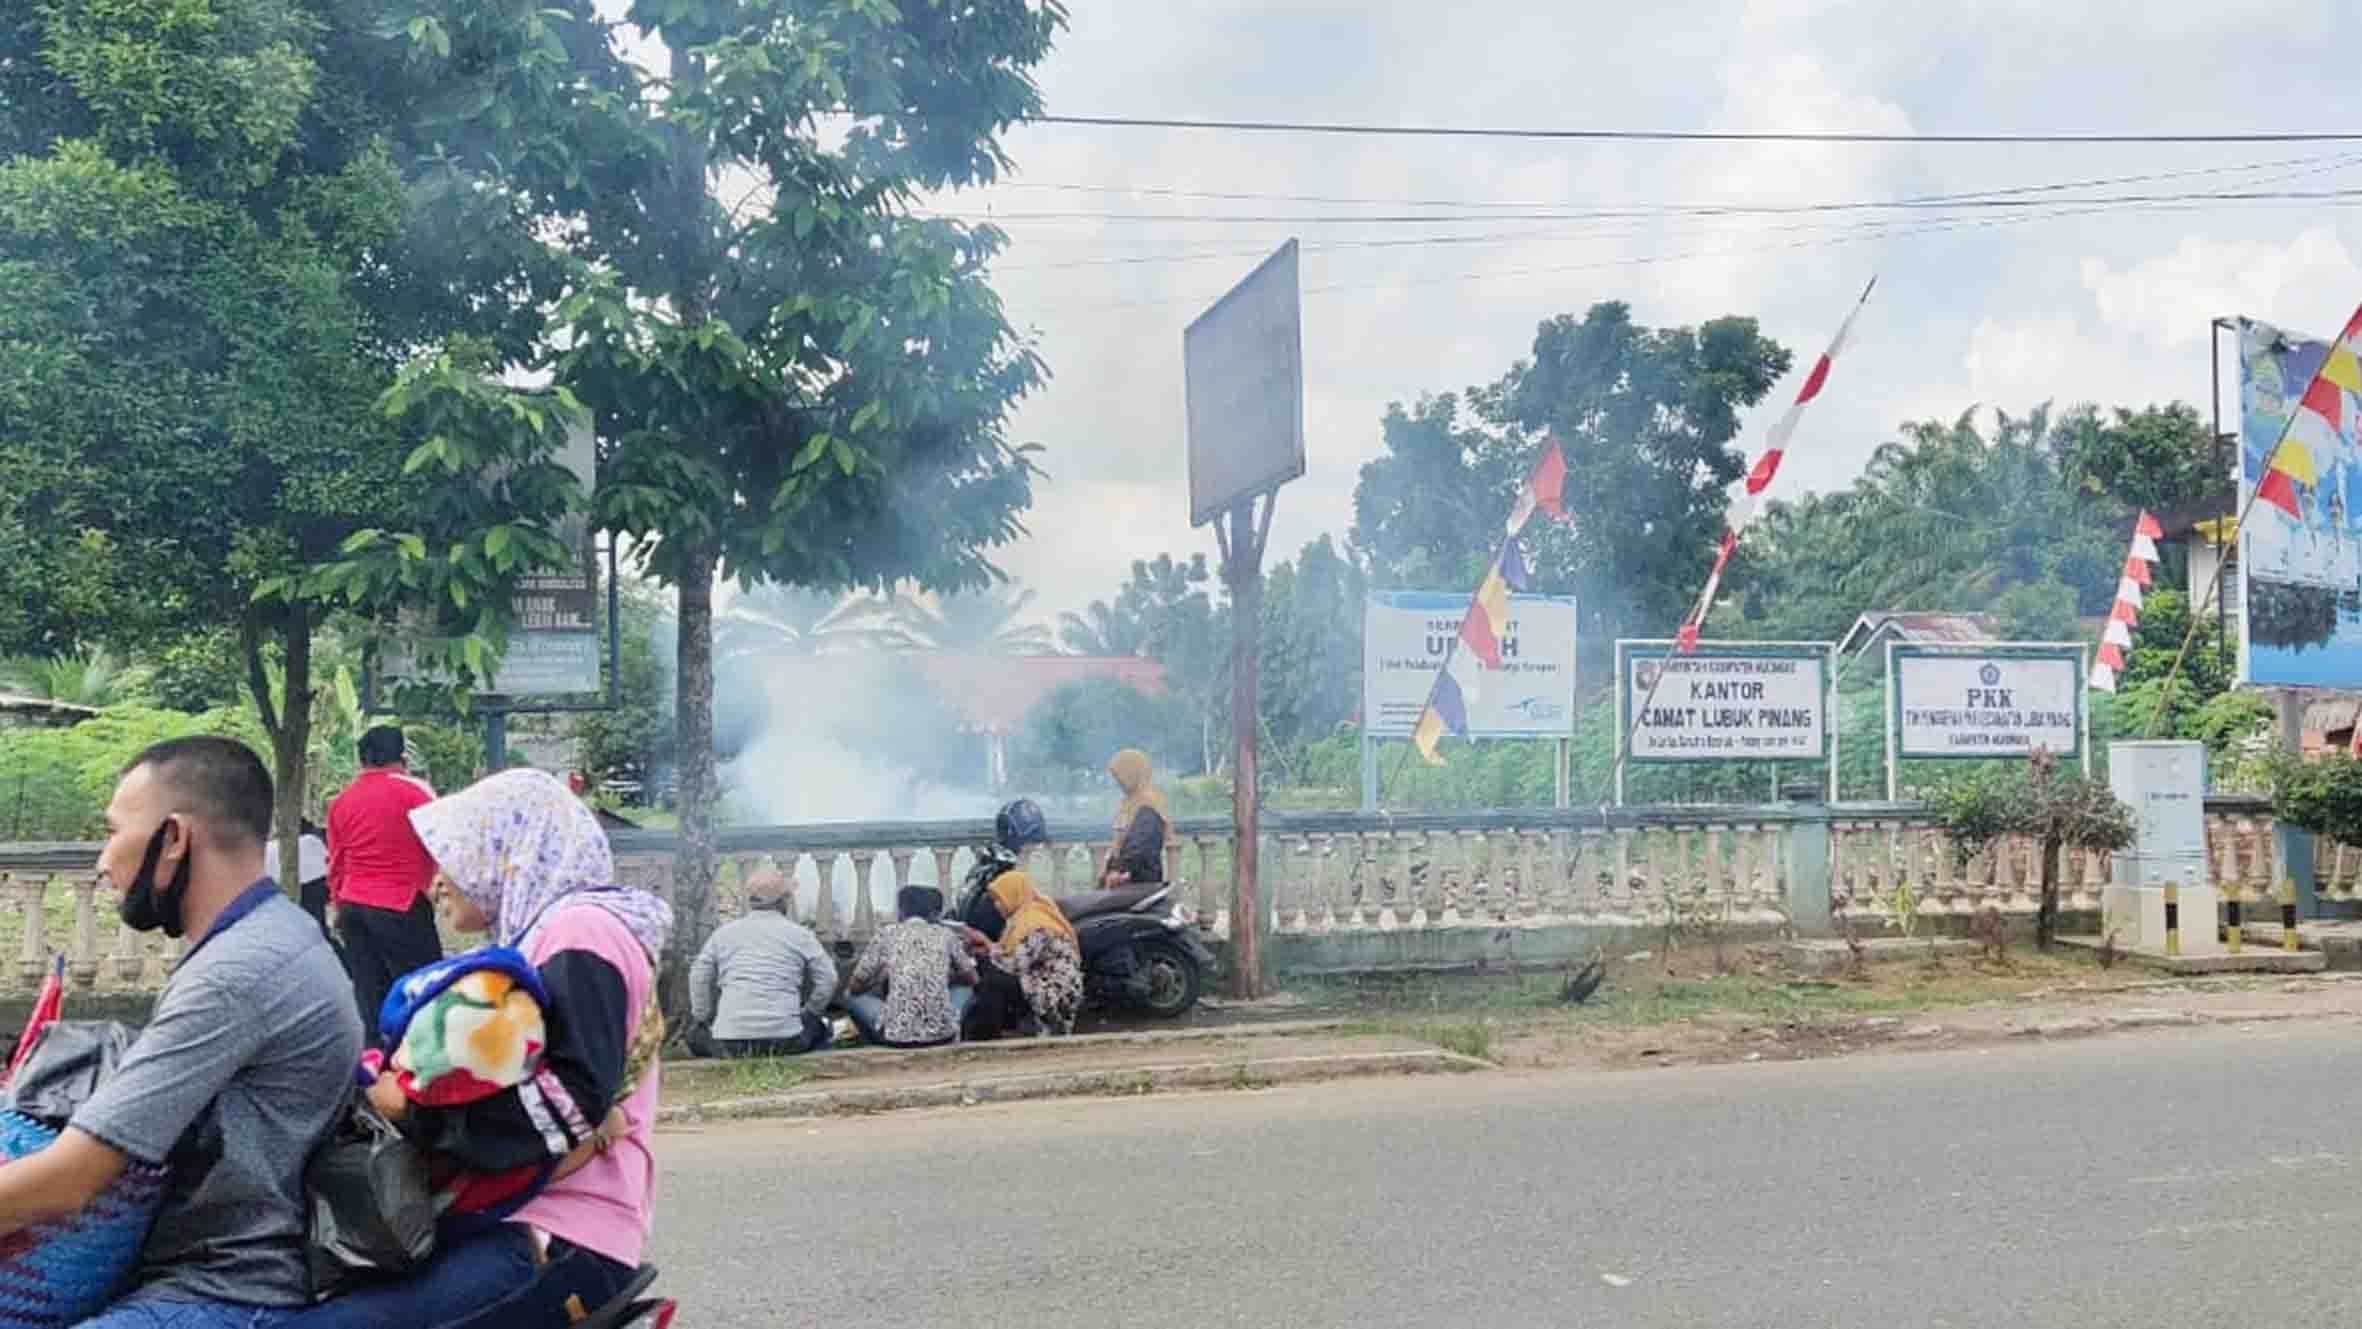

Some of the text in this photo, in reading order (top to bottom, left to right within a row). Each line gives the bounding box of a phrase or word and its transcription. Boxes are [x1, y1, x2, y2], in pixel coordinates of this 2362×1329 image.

[1690, 682, 1765, 700] KANTOR
[1967, 688, 2015, 708] PKK
[1641, 708, 1812, 728] CAMAT LUBUK PINANG
